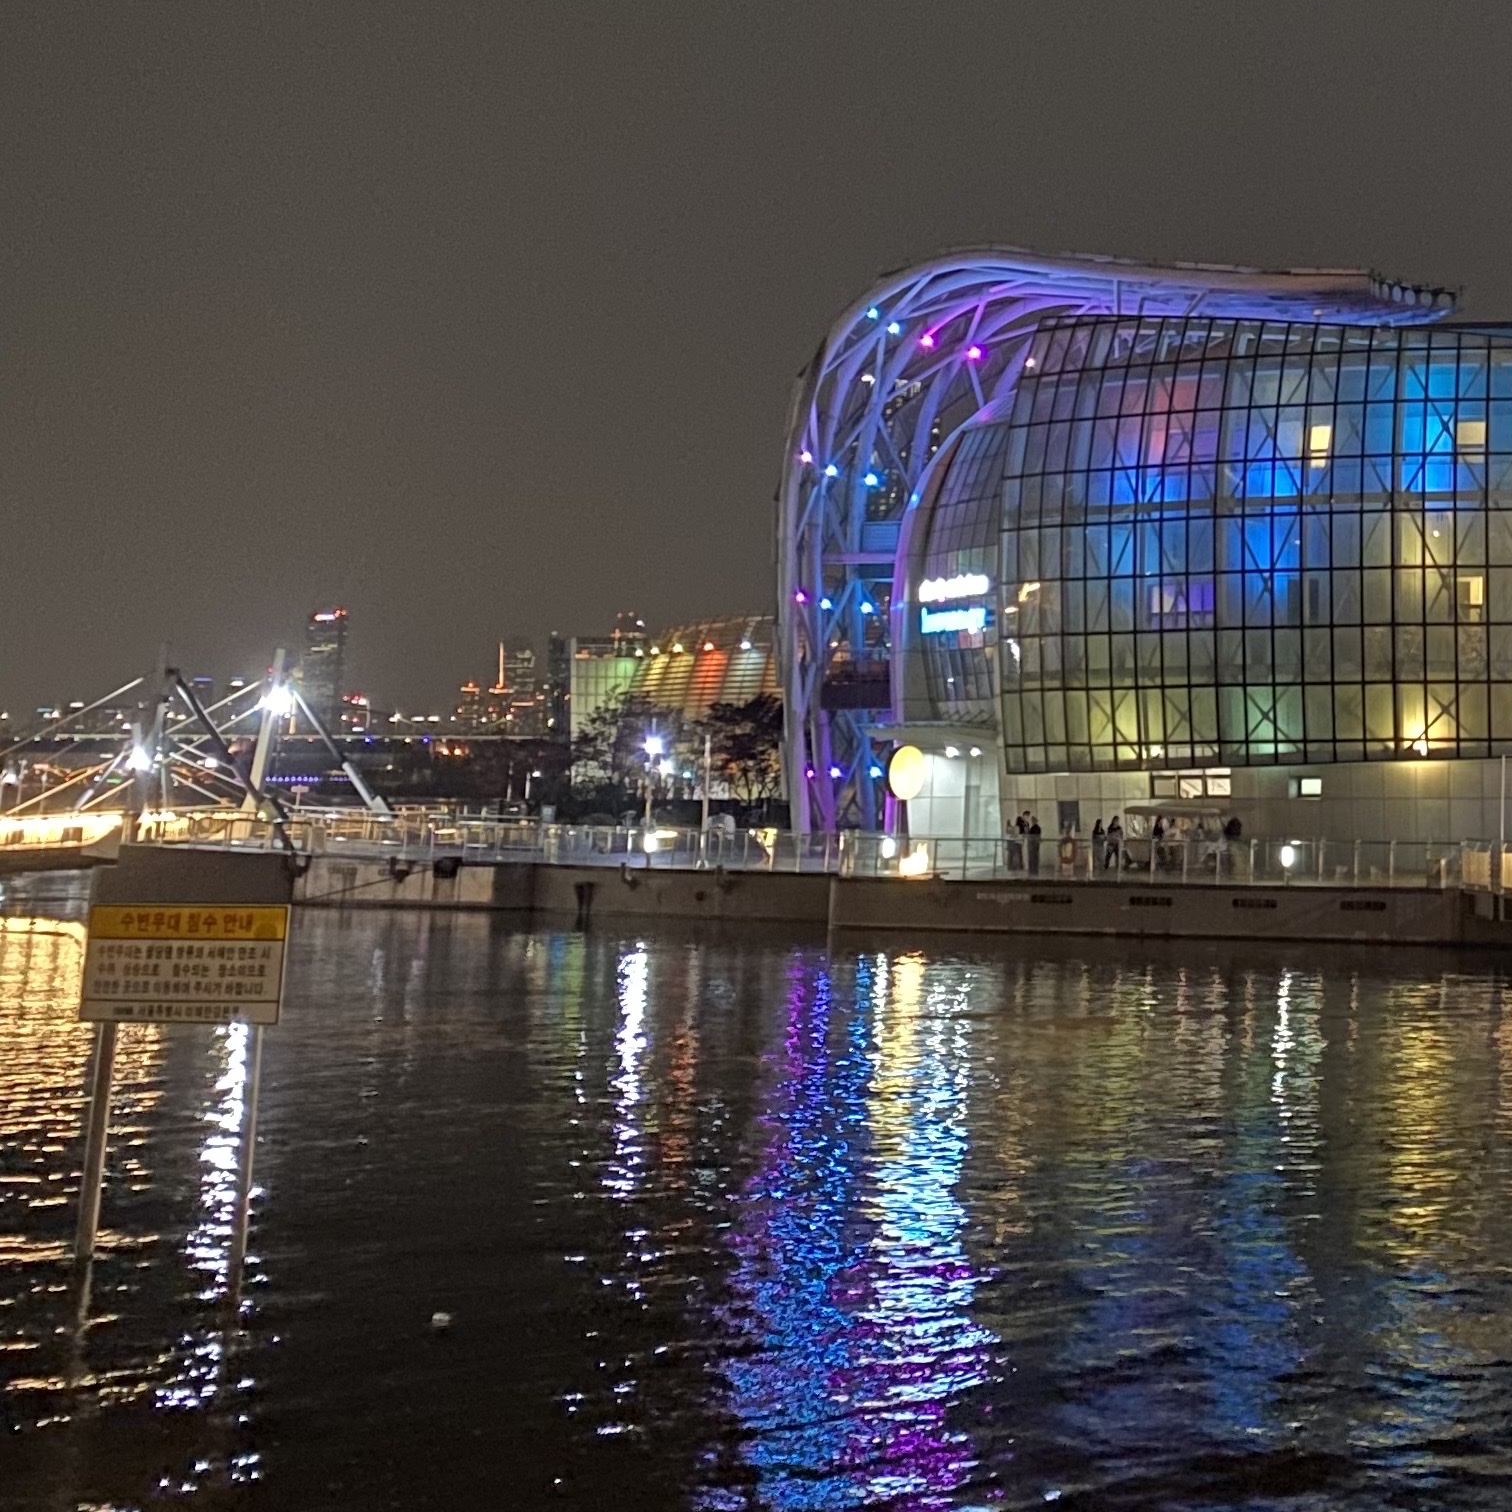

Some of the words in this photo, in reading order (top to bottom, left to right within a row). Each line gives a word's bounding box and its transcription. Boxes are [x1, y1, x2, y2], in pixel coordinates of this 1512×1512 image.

[120, 912, 181, 932] 수변무대
[187, 912, 217, 933] 침수
[223, 913, 254, 933] 안내
